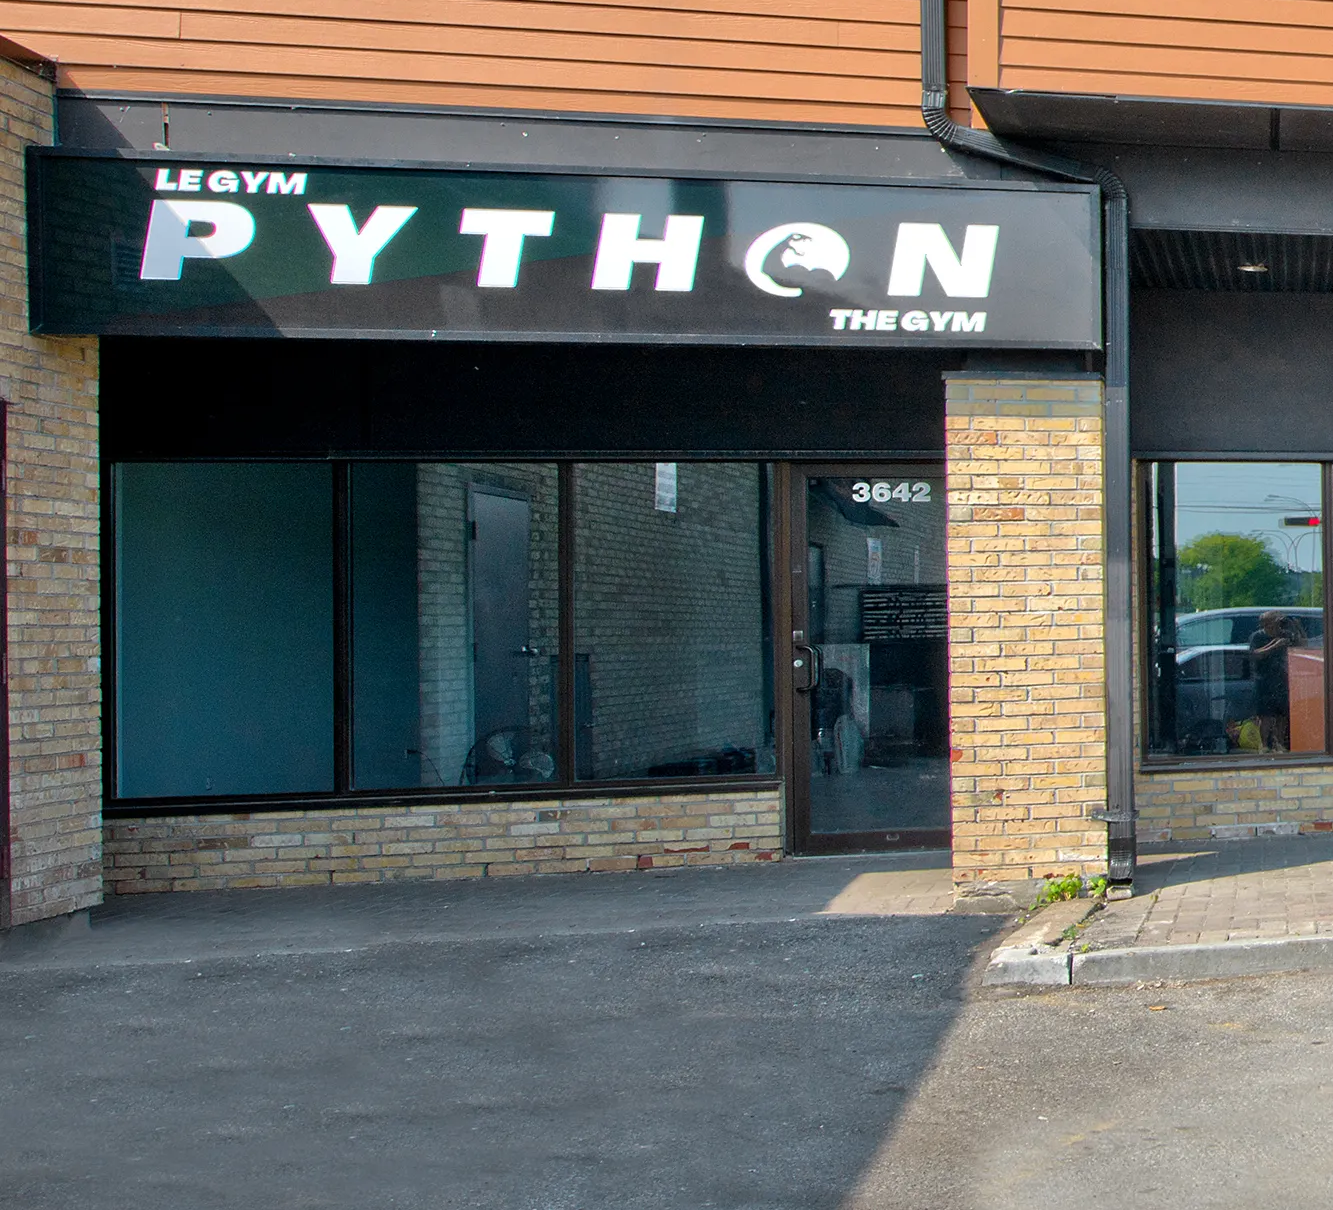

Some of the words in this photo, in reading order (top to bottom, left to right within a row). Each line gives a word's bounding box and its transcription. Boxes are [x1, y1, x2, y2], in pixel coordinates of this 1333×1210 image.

[155, 168, 203, 191] LE
[207, 171, 308, 195] GYM
[830, 307, 897, 331] THE
[901, 309, 987, 333] GYM
[852, 482, 931, 503] 3642
